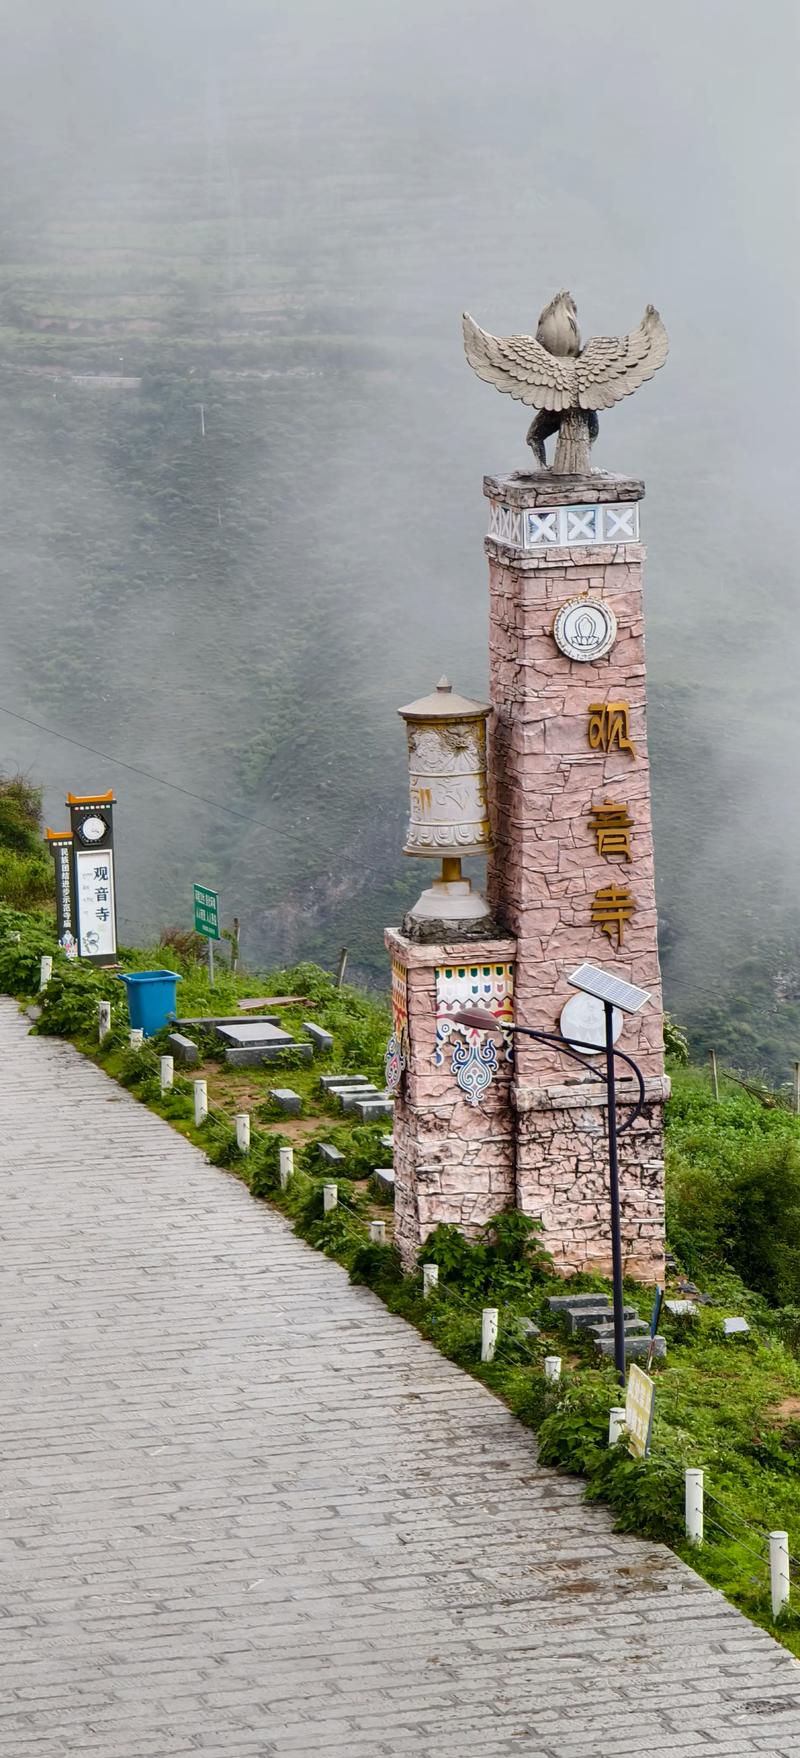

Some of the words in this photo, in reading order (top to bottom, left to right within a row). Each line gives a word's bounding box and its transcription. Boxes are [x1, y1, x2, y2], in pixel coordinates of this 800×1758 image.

[93, 866, 110, 922] 观音寺
[587, 702, 636, 947] 观音寺
